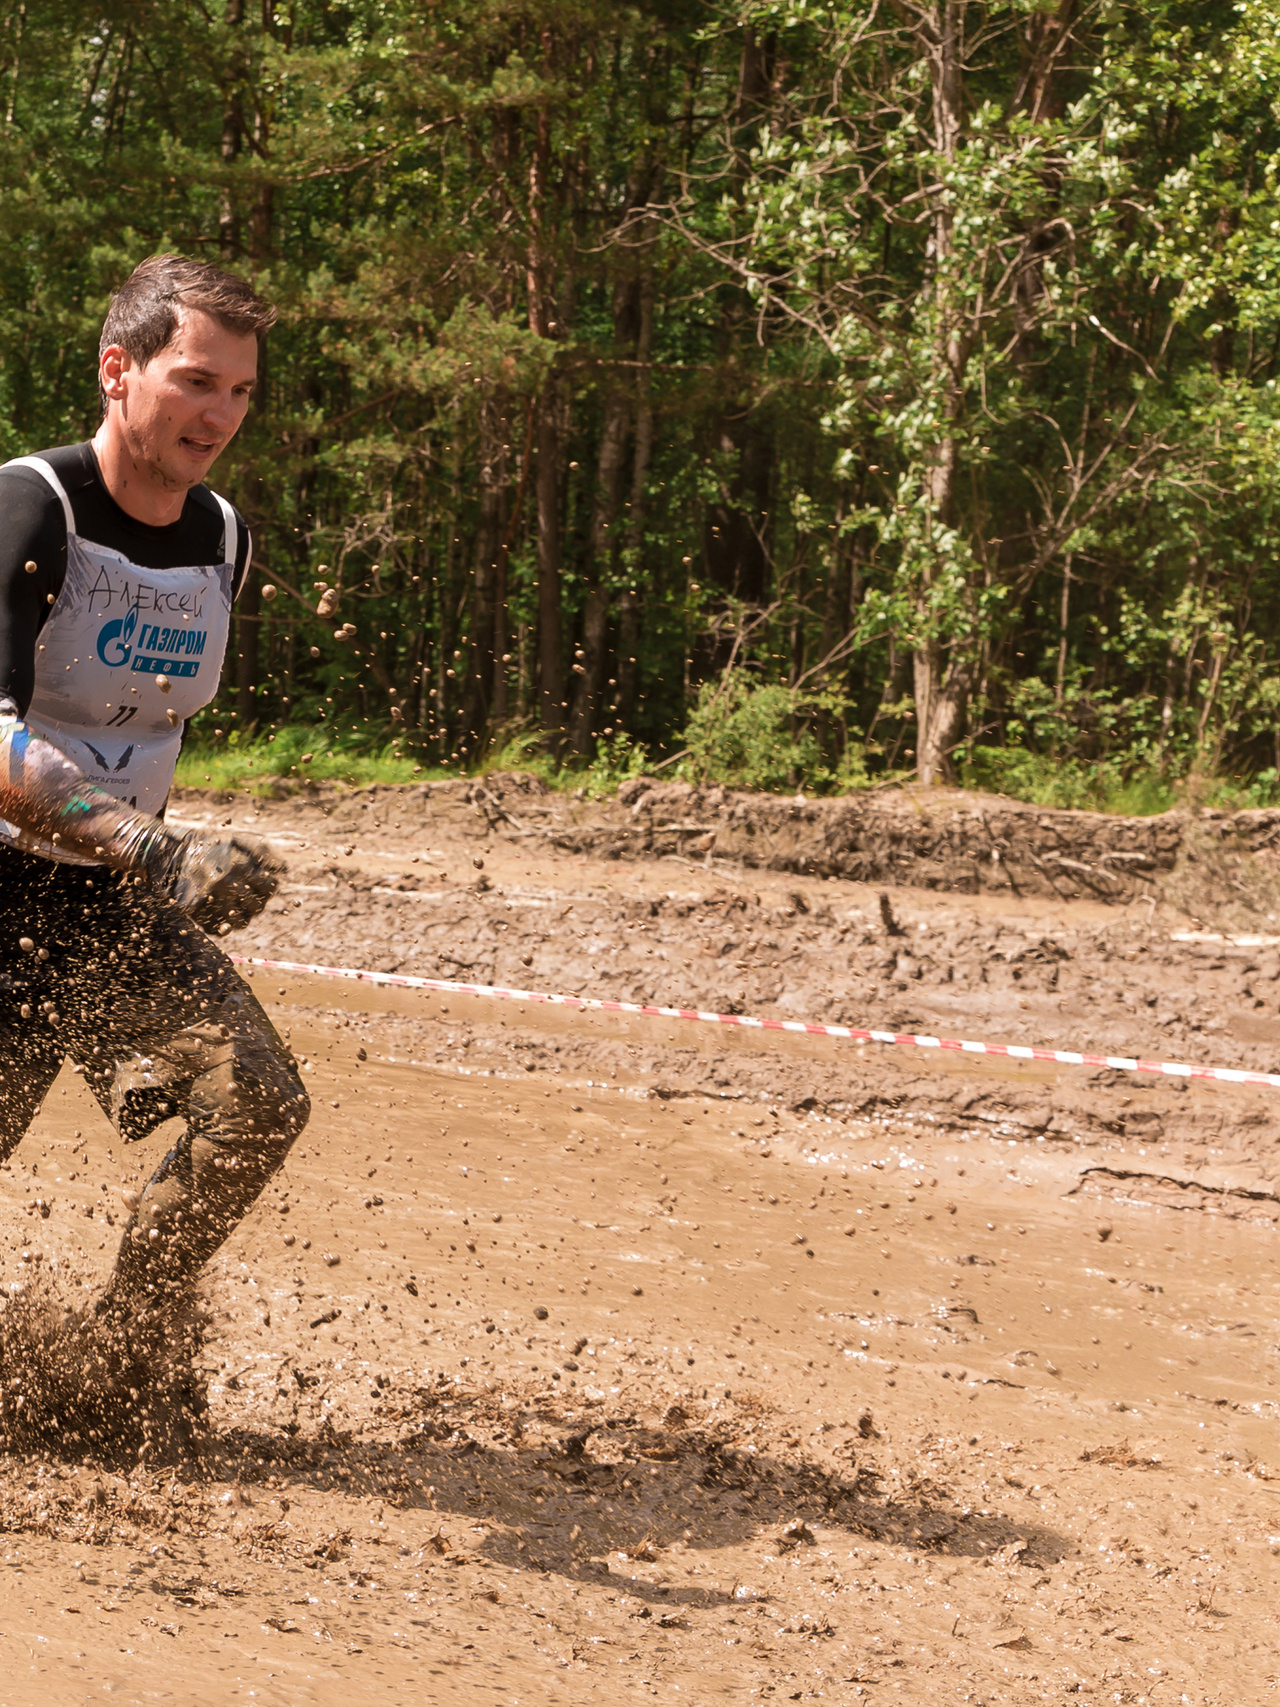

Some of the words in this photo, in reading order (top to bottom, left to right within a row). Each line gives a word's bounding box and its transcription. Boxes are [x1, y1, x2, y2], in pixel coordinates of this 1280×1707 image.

[137, 623, 207, 655] ГАЗПРОМ
[134, 658, 197, 676] НЕФТЬ
[106, 705, 138, 727] 11
